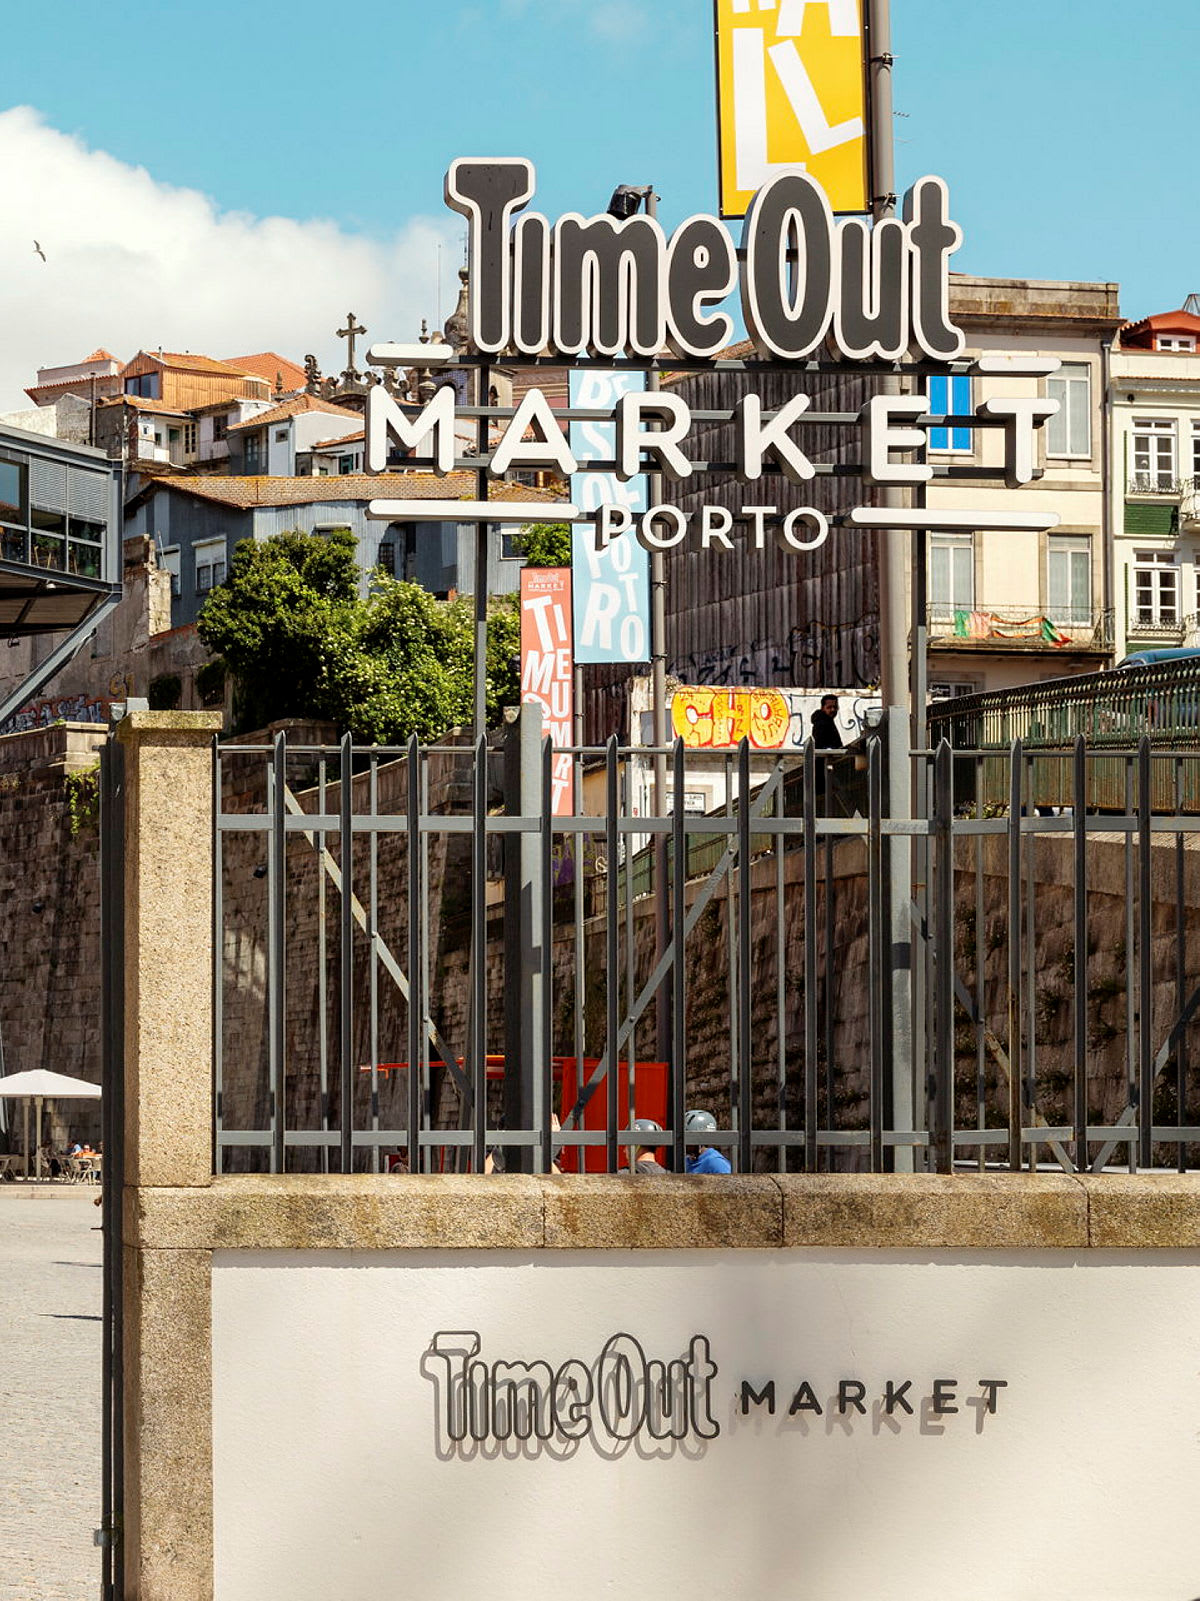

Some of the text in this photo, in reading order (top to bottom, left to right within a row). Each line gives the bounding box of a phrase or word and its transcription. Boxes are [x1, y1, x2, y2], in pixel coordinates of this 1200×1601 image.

[366, 385, 1061, 488] MARKET
[596, 505, 829, 552] PORTO
[740, 1379, 1008, 1415] MARKET
